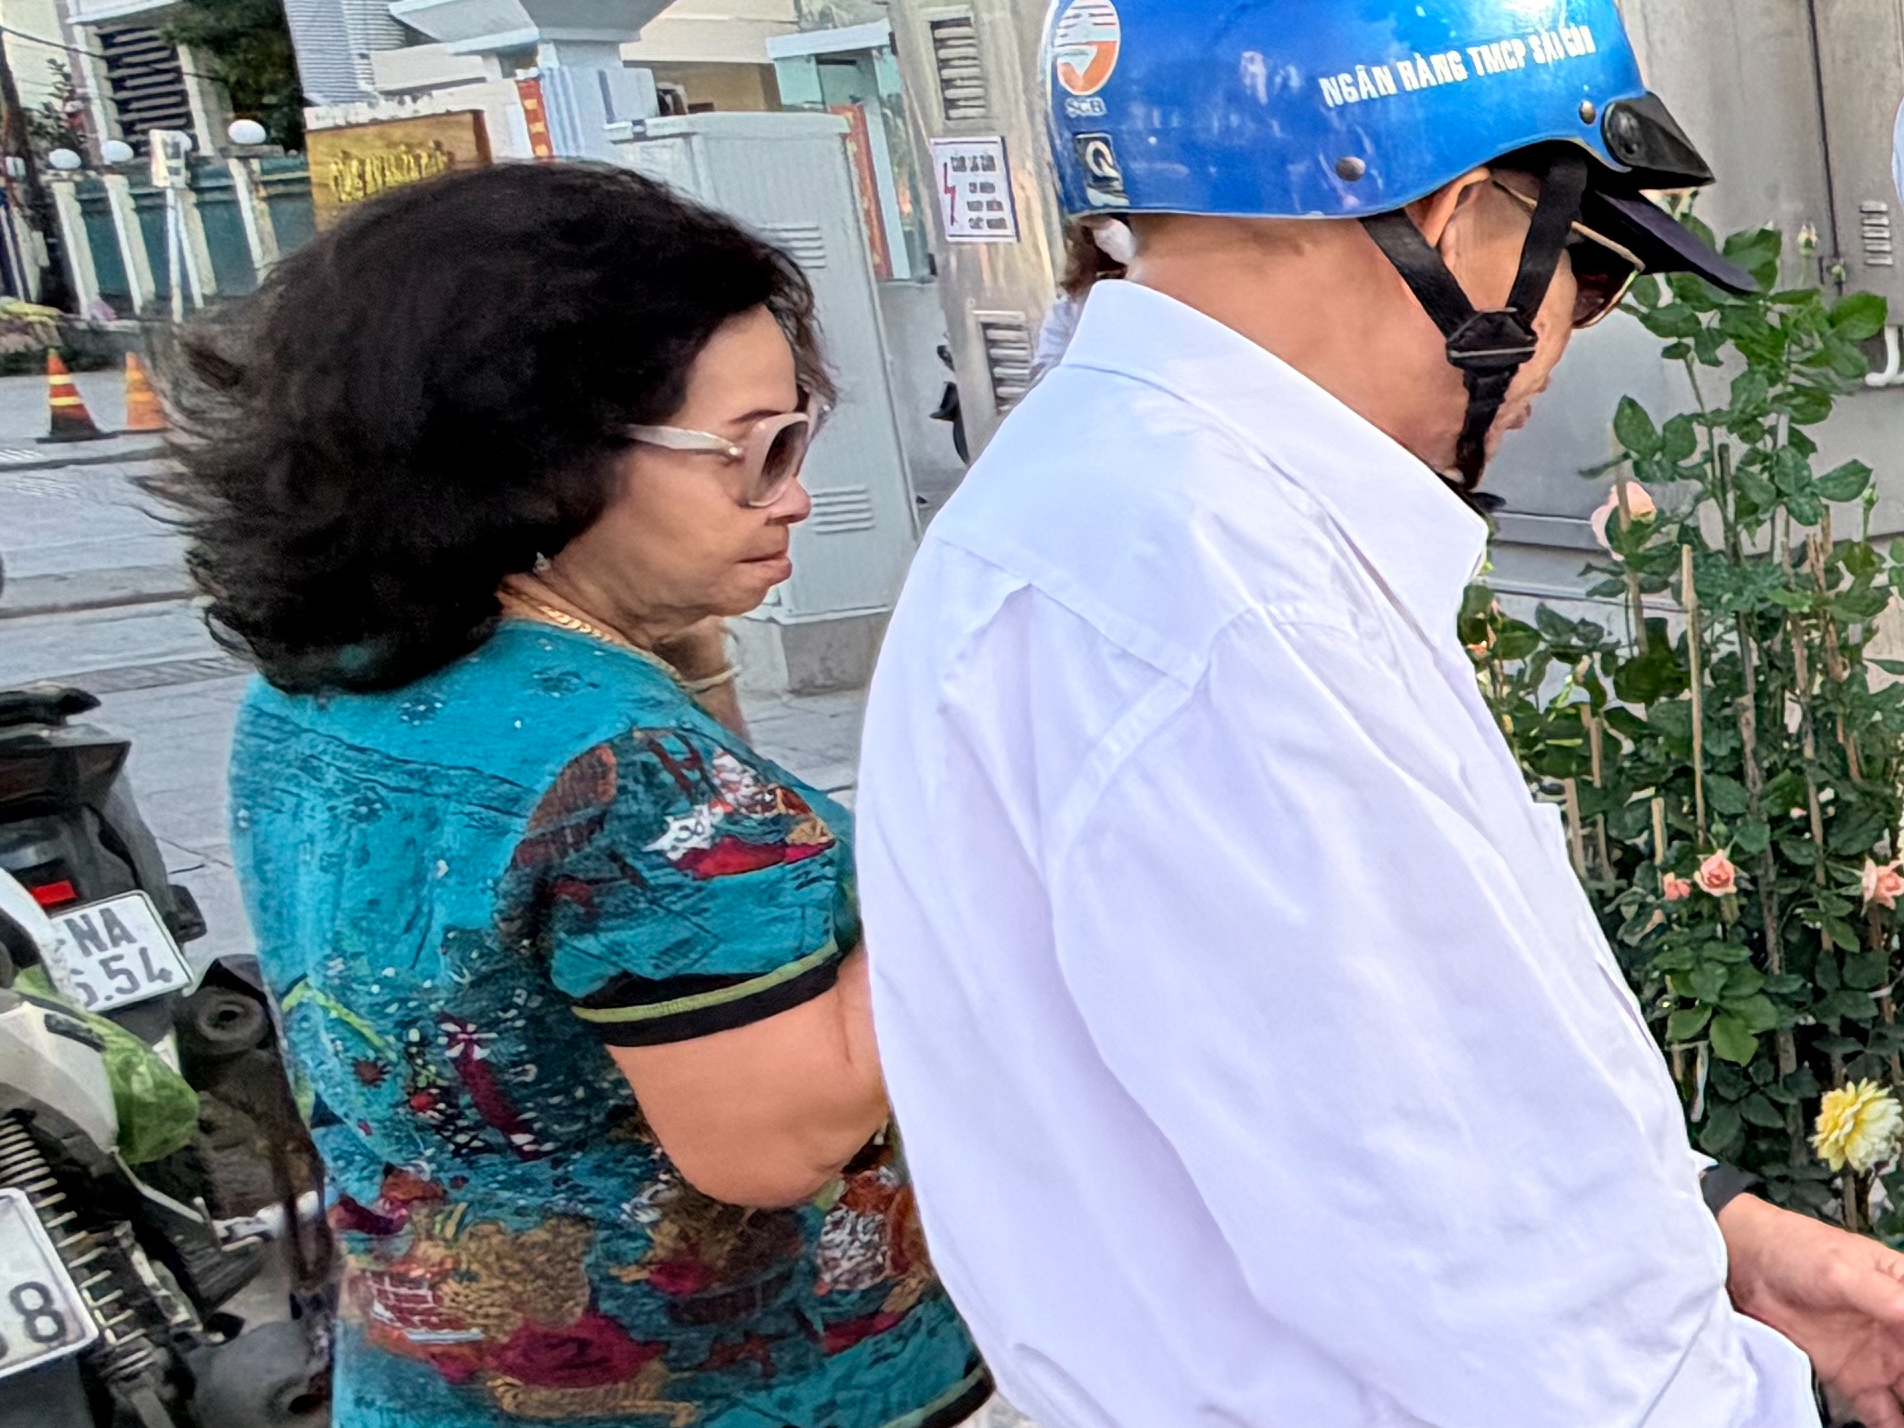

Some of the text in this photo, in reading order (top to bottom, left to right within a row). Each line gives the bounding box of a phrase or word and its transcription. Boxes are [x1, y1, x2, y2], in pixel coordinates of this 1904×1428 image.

[1318, 64, 1398, 108] NGÂN
[1396, 51, 1469, 92] HÀNG
[1466, 38, 1527, 76] TMCP
